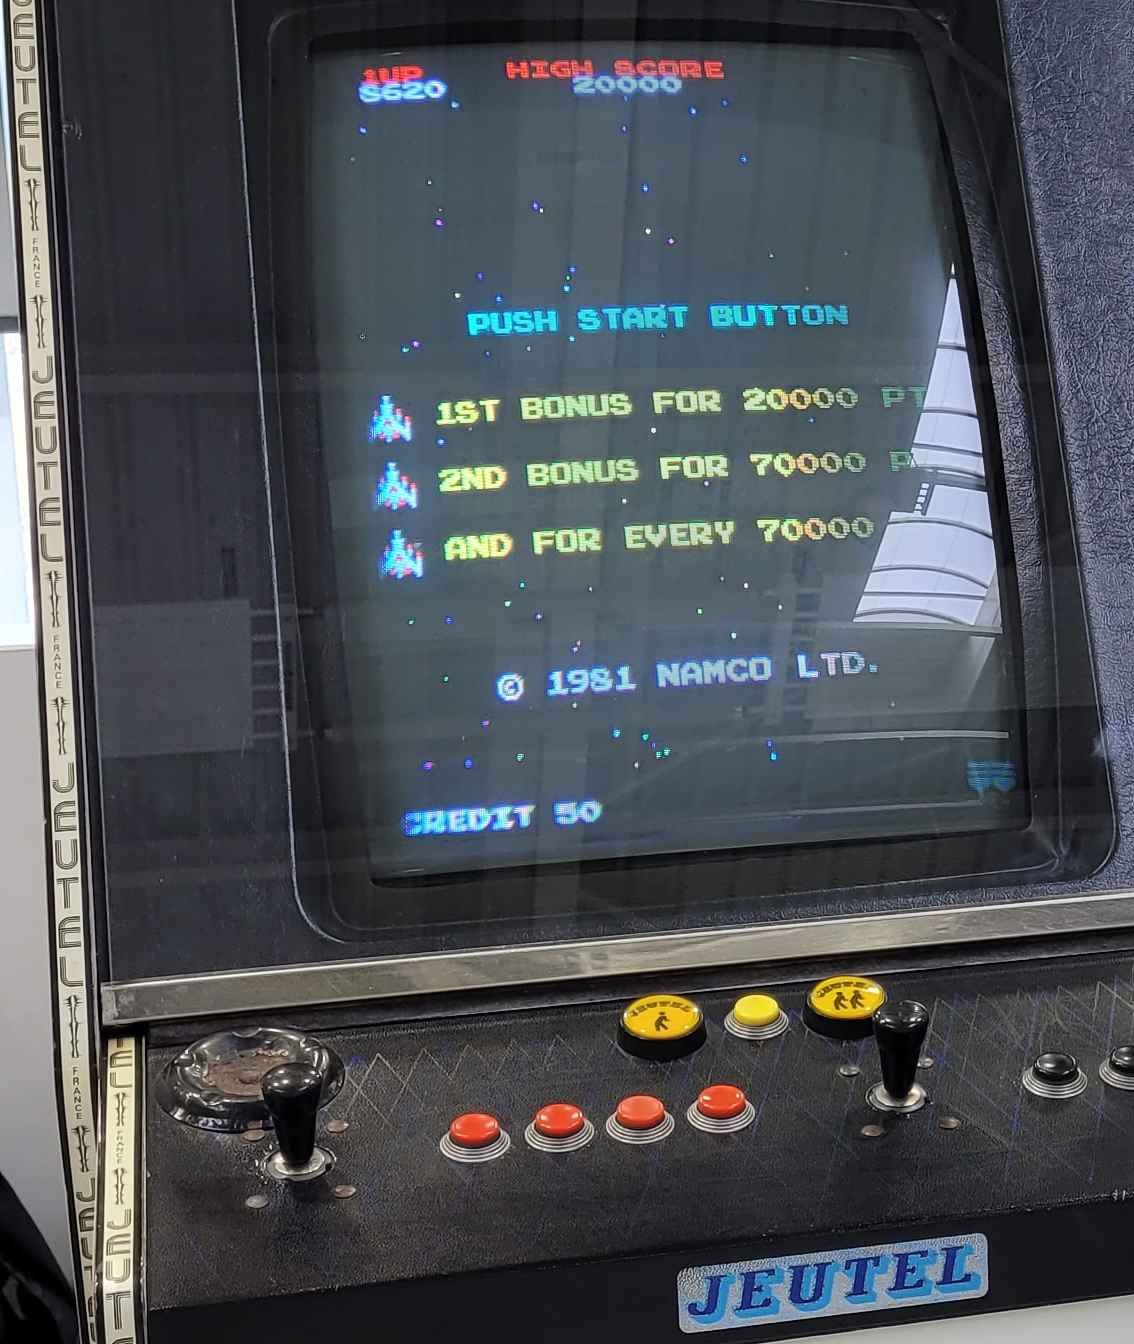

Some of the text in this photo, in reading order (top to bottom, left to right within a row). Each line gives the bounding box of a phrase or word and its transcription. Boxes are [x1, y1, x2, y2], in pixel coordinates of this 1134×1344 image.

[506, 58, 725, 80] HIGH SCORE
[571, 76, 682, 96] 20000
[32, 237, 41, 289] FRANCE
[467, 302, 849, 337] PUSH START BUTTON
[436, 398, 501, 427] 1ST
[520, 392, 634, 421] BONUS
[652, 389, 723, 415] FOR
[743, 387, 859, 412] 20000
[32, 355, 64, 562] JEUTEL
[438, 464, 508, 493] 2ND
[527, 459, 641, 488] BONUS
[659, 454, 730, 480] FOR
[750, 452, 867, 477] 70000
[444, 517, 875, 561] AND FOR EVERY 70000
[52, 634, 63, 690] FRANCE
[547, 666, 637, 698] 1981
[657, 657, 772, 689] NAMCO
[797, 651, 879, 680] LTD.
[403, 799, 602, 838] CREDIT 50
[52, 762, 83, 987] JEUTEL
[71, 1066, 83, 1120] FRANCE
[688, 1243, 981, 1325] JEUTEL
